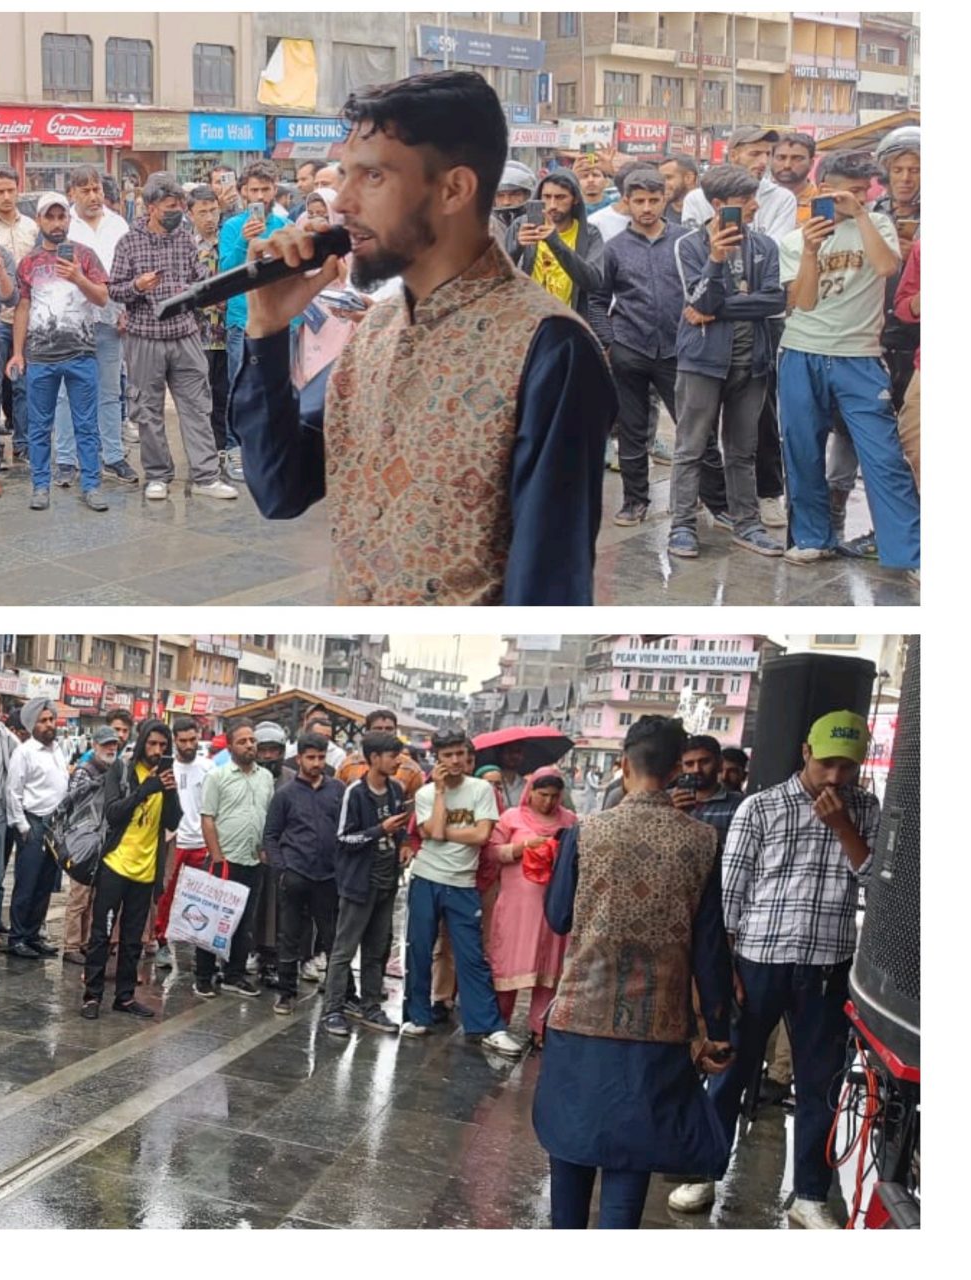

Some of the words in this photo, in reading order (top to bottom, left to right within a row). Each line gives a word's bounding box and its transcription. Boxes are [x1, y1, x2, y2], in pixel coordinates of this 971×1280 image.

[794, 66, 819, 78] HOTEL
[46, 112, 126, 138] Companion
[288, 123, 343, 137] SAMSUNG
[635, 124, 667, 138] TITAN
[615, 653, 637, 663] PEAK
[639, 653, 660, 664] VIEW
[661, 653, 688, 665] HOTEL
[691, 654, 697, 665] &
[700, 654, 755, 667] RESTAURANT
